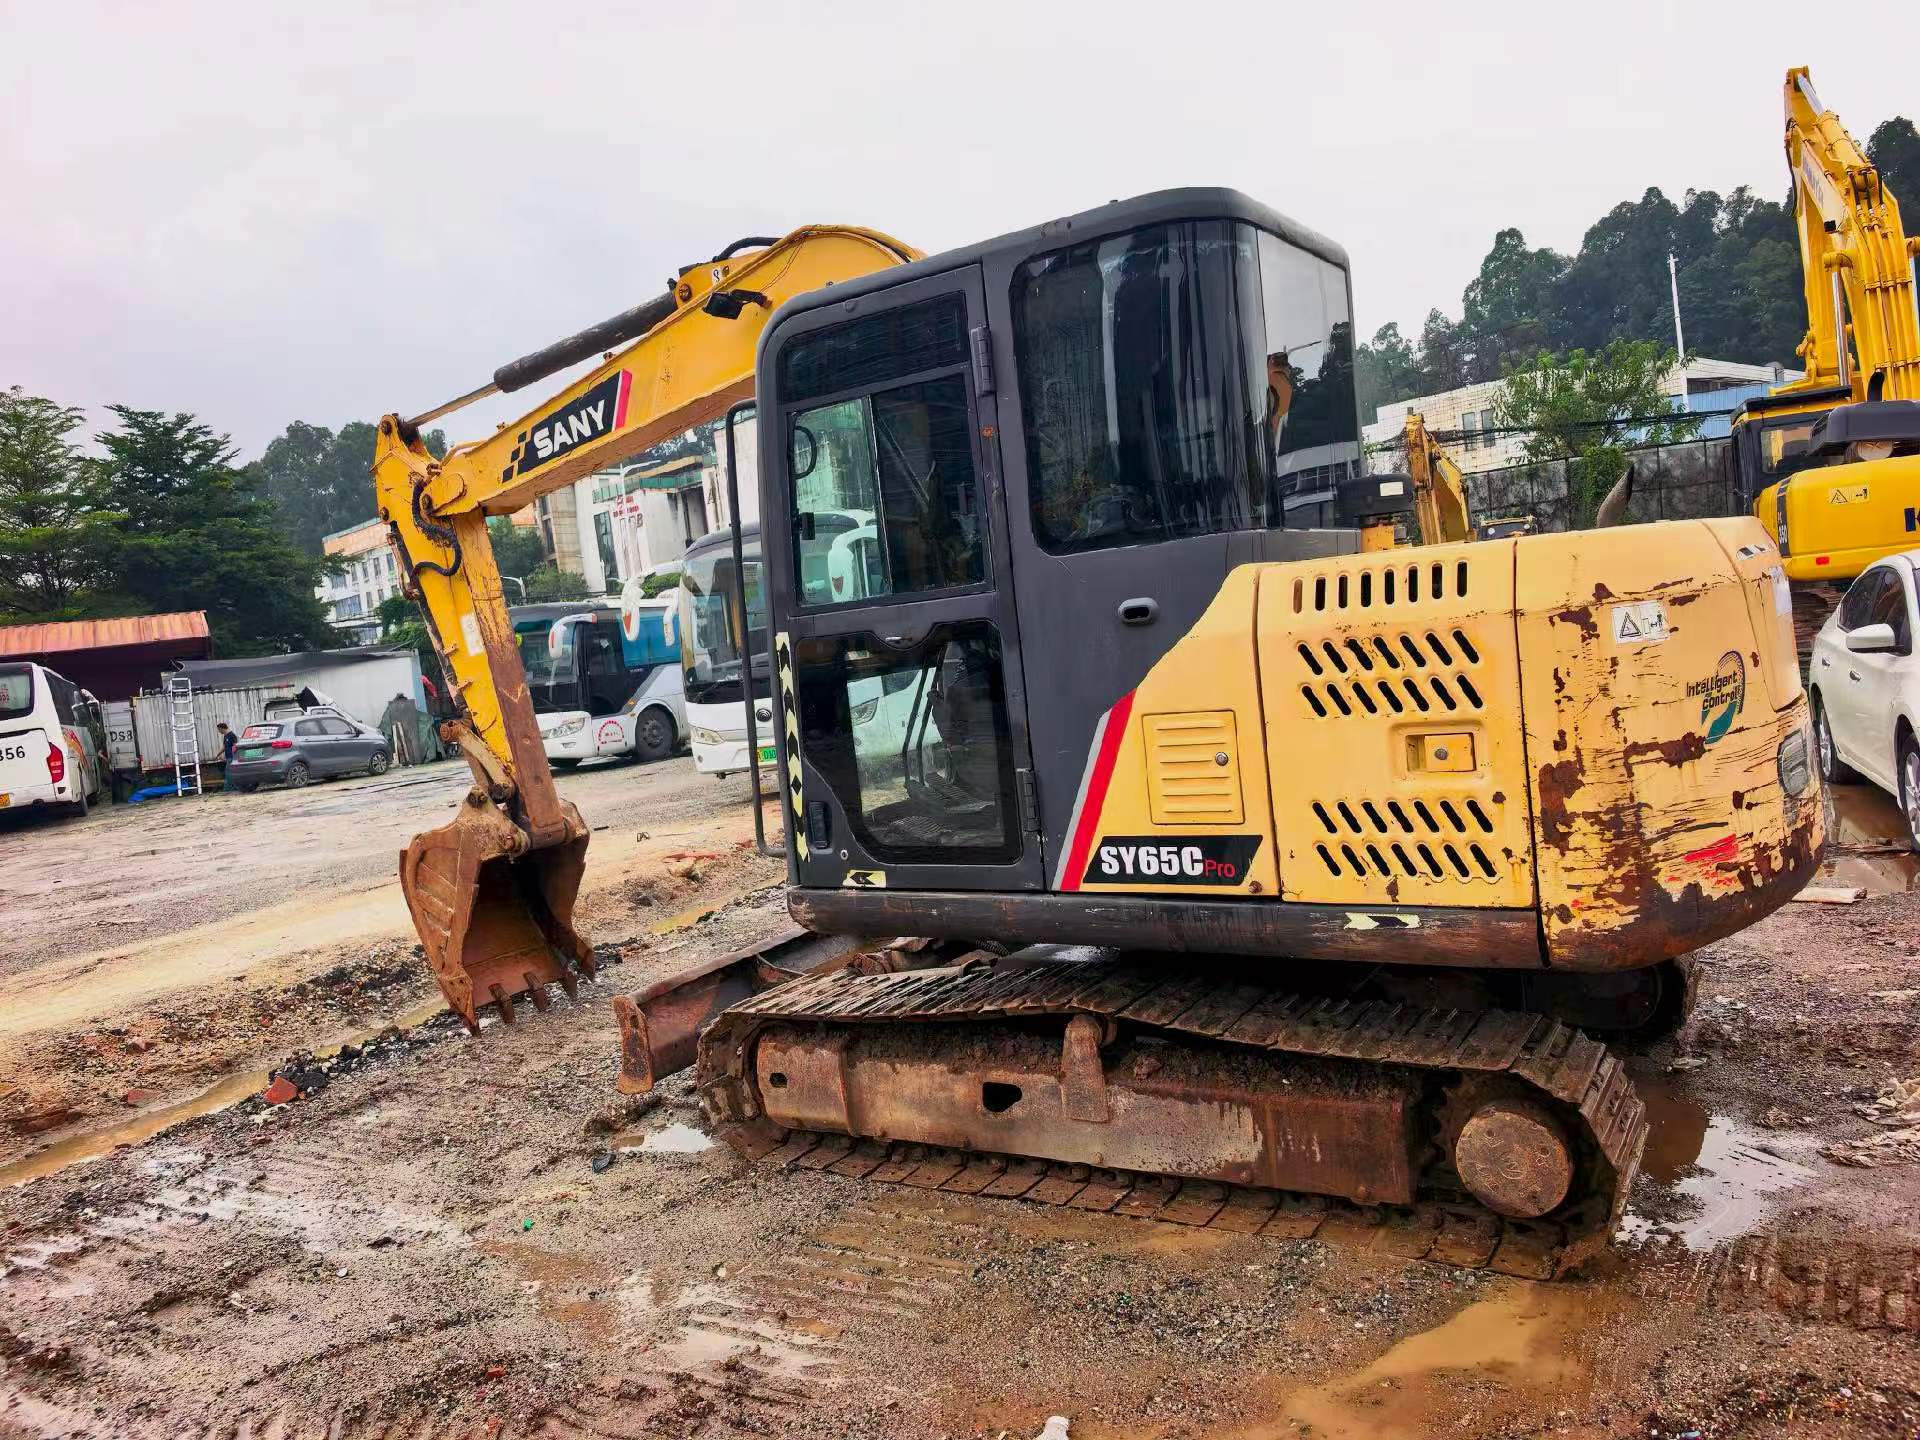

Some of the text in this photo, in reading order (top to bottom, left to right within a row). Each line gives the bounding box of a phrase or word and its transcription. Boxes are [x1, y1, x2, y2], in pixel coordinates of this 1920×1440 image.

[533, 400, 605, 459] SANY
[1687, 670, 1738, 697] Intelligent
[1100, 846, 1236, 878] SY65C Pro
